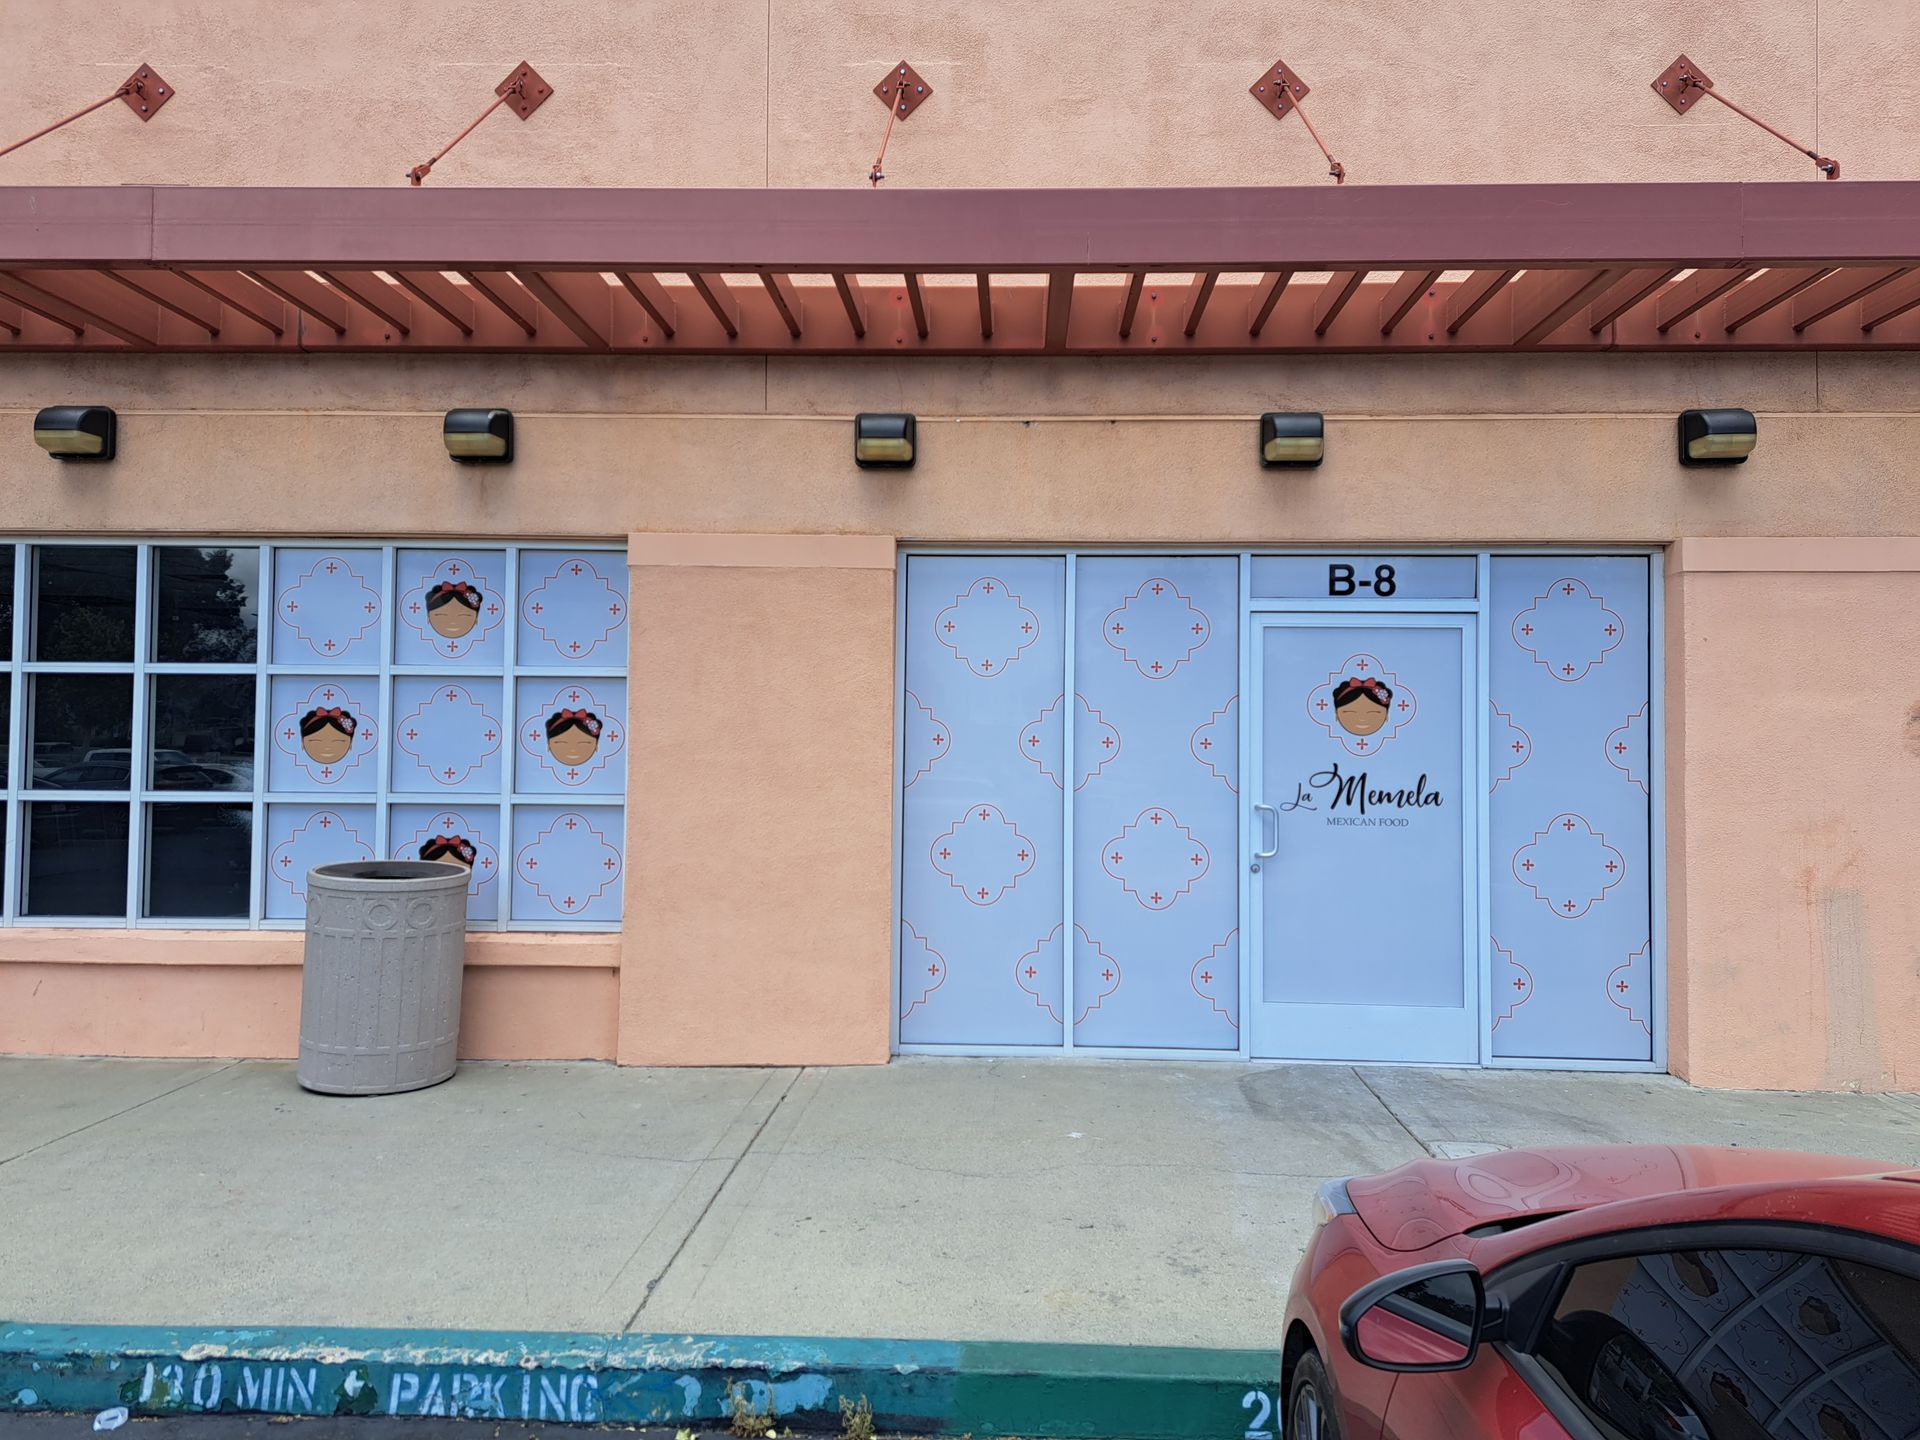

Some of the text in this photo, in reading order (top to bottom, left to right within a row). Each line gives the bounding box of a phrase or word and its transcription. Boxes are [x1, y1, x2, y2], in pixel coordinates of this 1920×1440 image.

[1328, 563, 1397, 598] B-8
[1279, 762, 1444, 816] La Memela
[1326, 816, 1410, 828] MEXICAN FOOD
[236, 1365, 317, 1411] MIN
[388, 1372, 599, 1422] PARKING
[1242, 1390, 1282, 1440] 2
